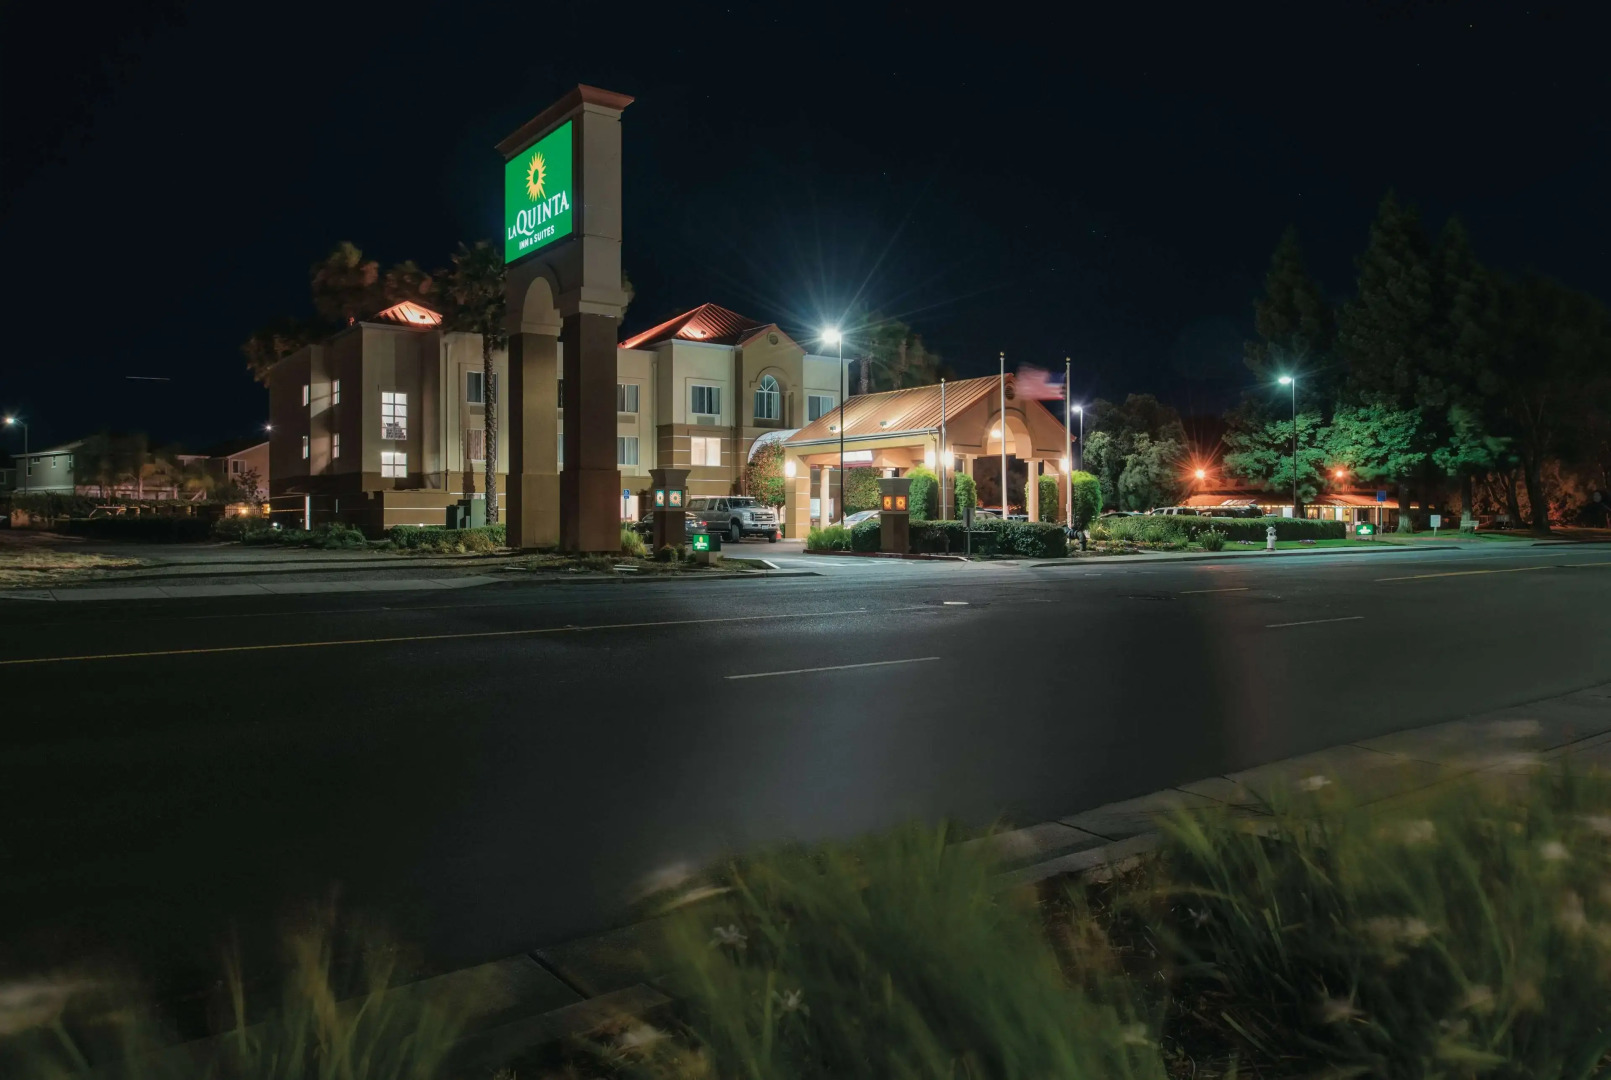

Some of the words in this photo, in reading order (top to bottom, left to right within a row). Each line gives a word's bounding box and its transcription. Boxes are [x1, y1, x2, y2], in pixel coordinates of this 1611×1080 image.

[508, 225, 517, 240] LA
[516, 190, 570, 236] QUINTA
[519, 238, 529, 251] INN
[534, 225, 555, 243] SUITES
